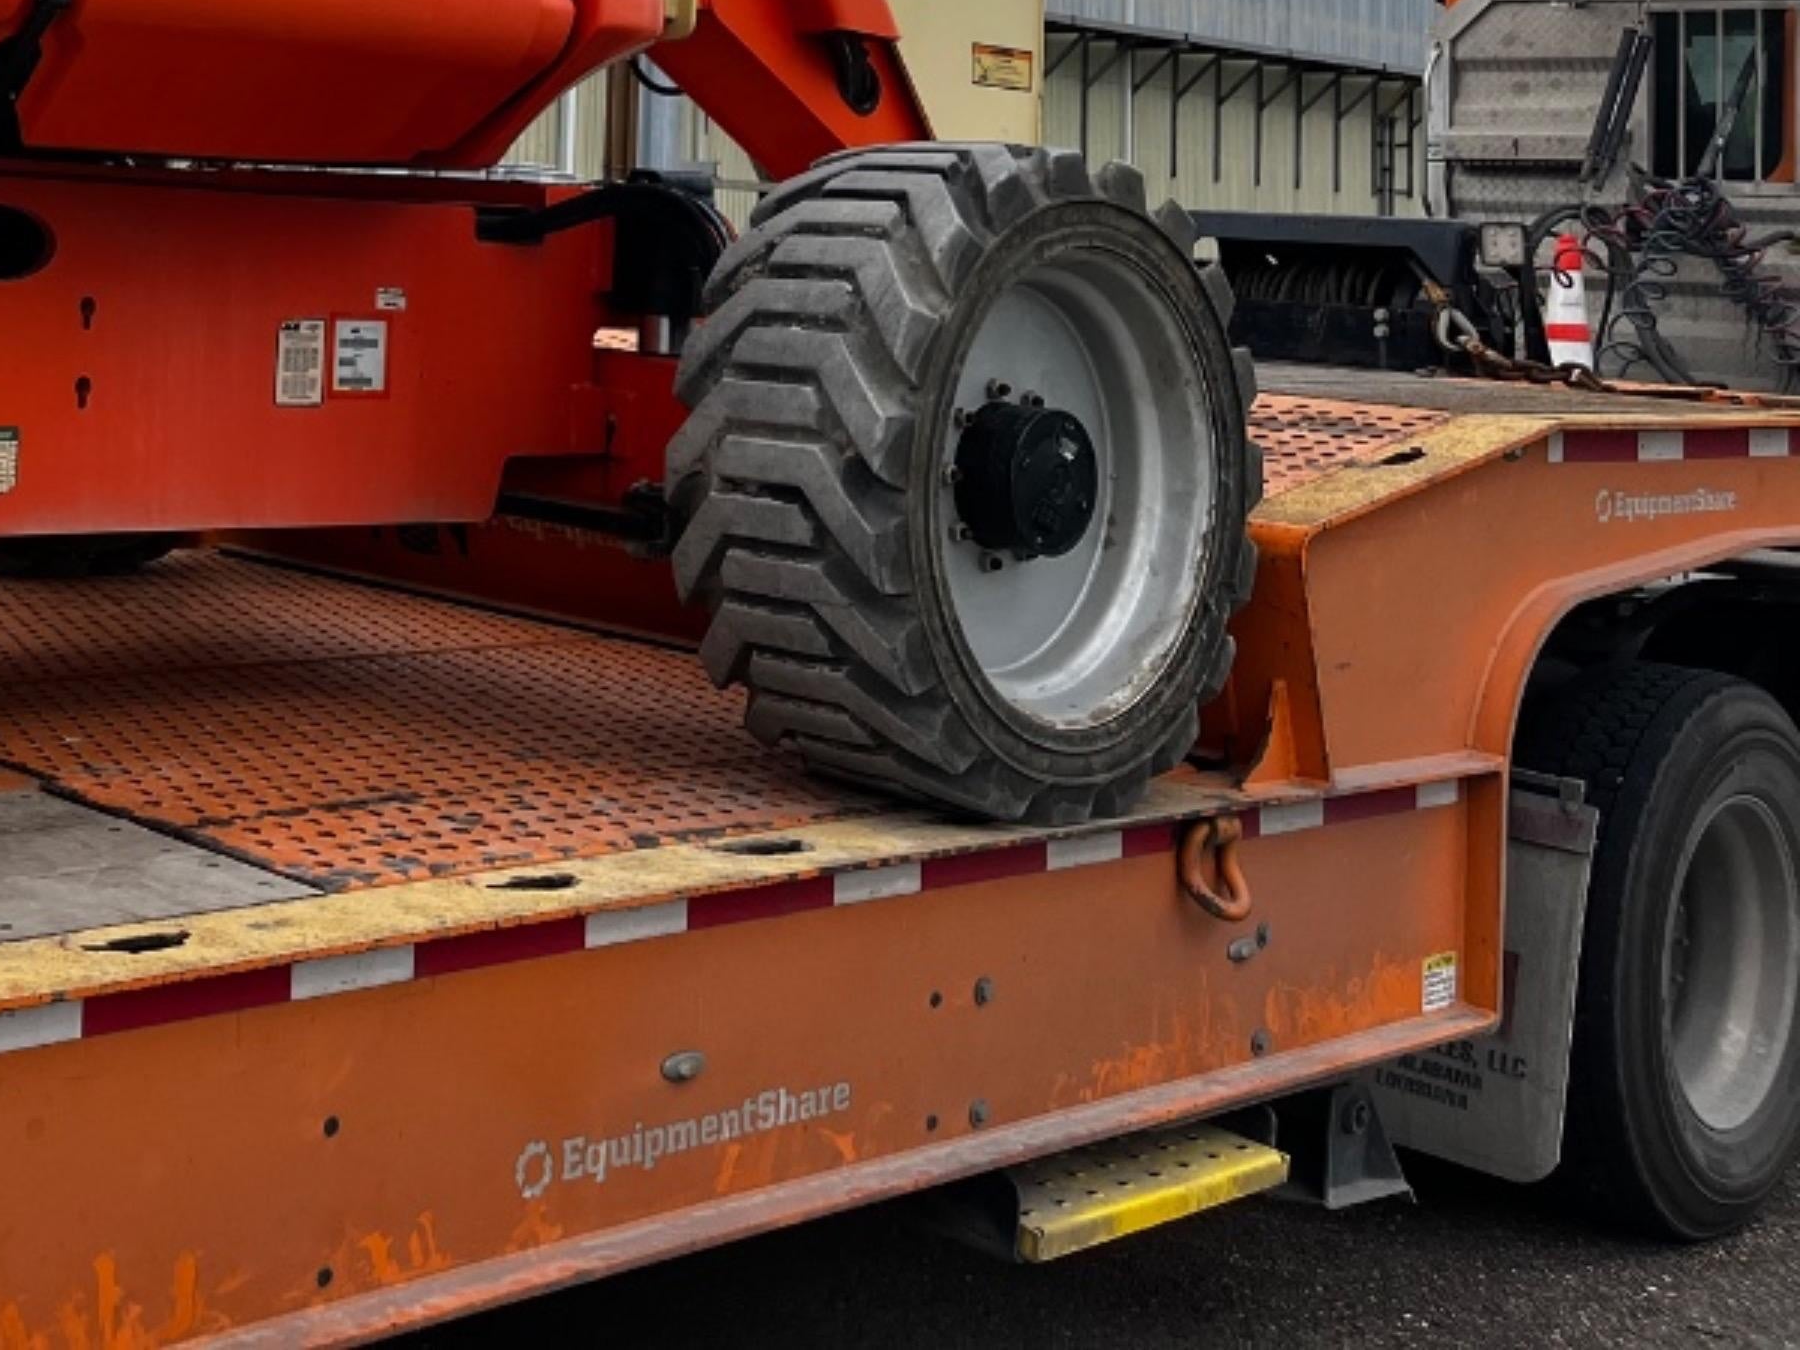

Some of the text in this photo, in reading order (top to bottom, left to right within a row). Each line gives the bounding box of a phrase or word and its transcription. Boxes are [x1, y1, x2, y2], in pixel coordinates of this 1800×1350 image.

[1613, 489, 1737, 523] EquipmentShare
[1486, 1048, 1528, 1080] LLC
[561, 1081, 851, 1182] EquipmentShare
